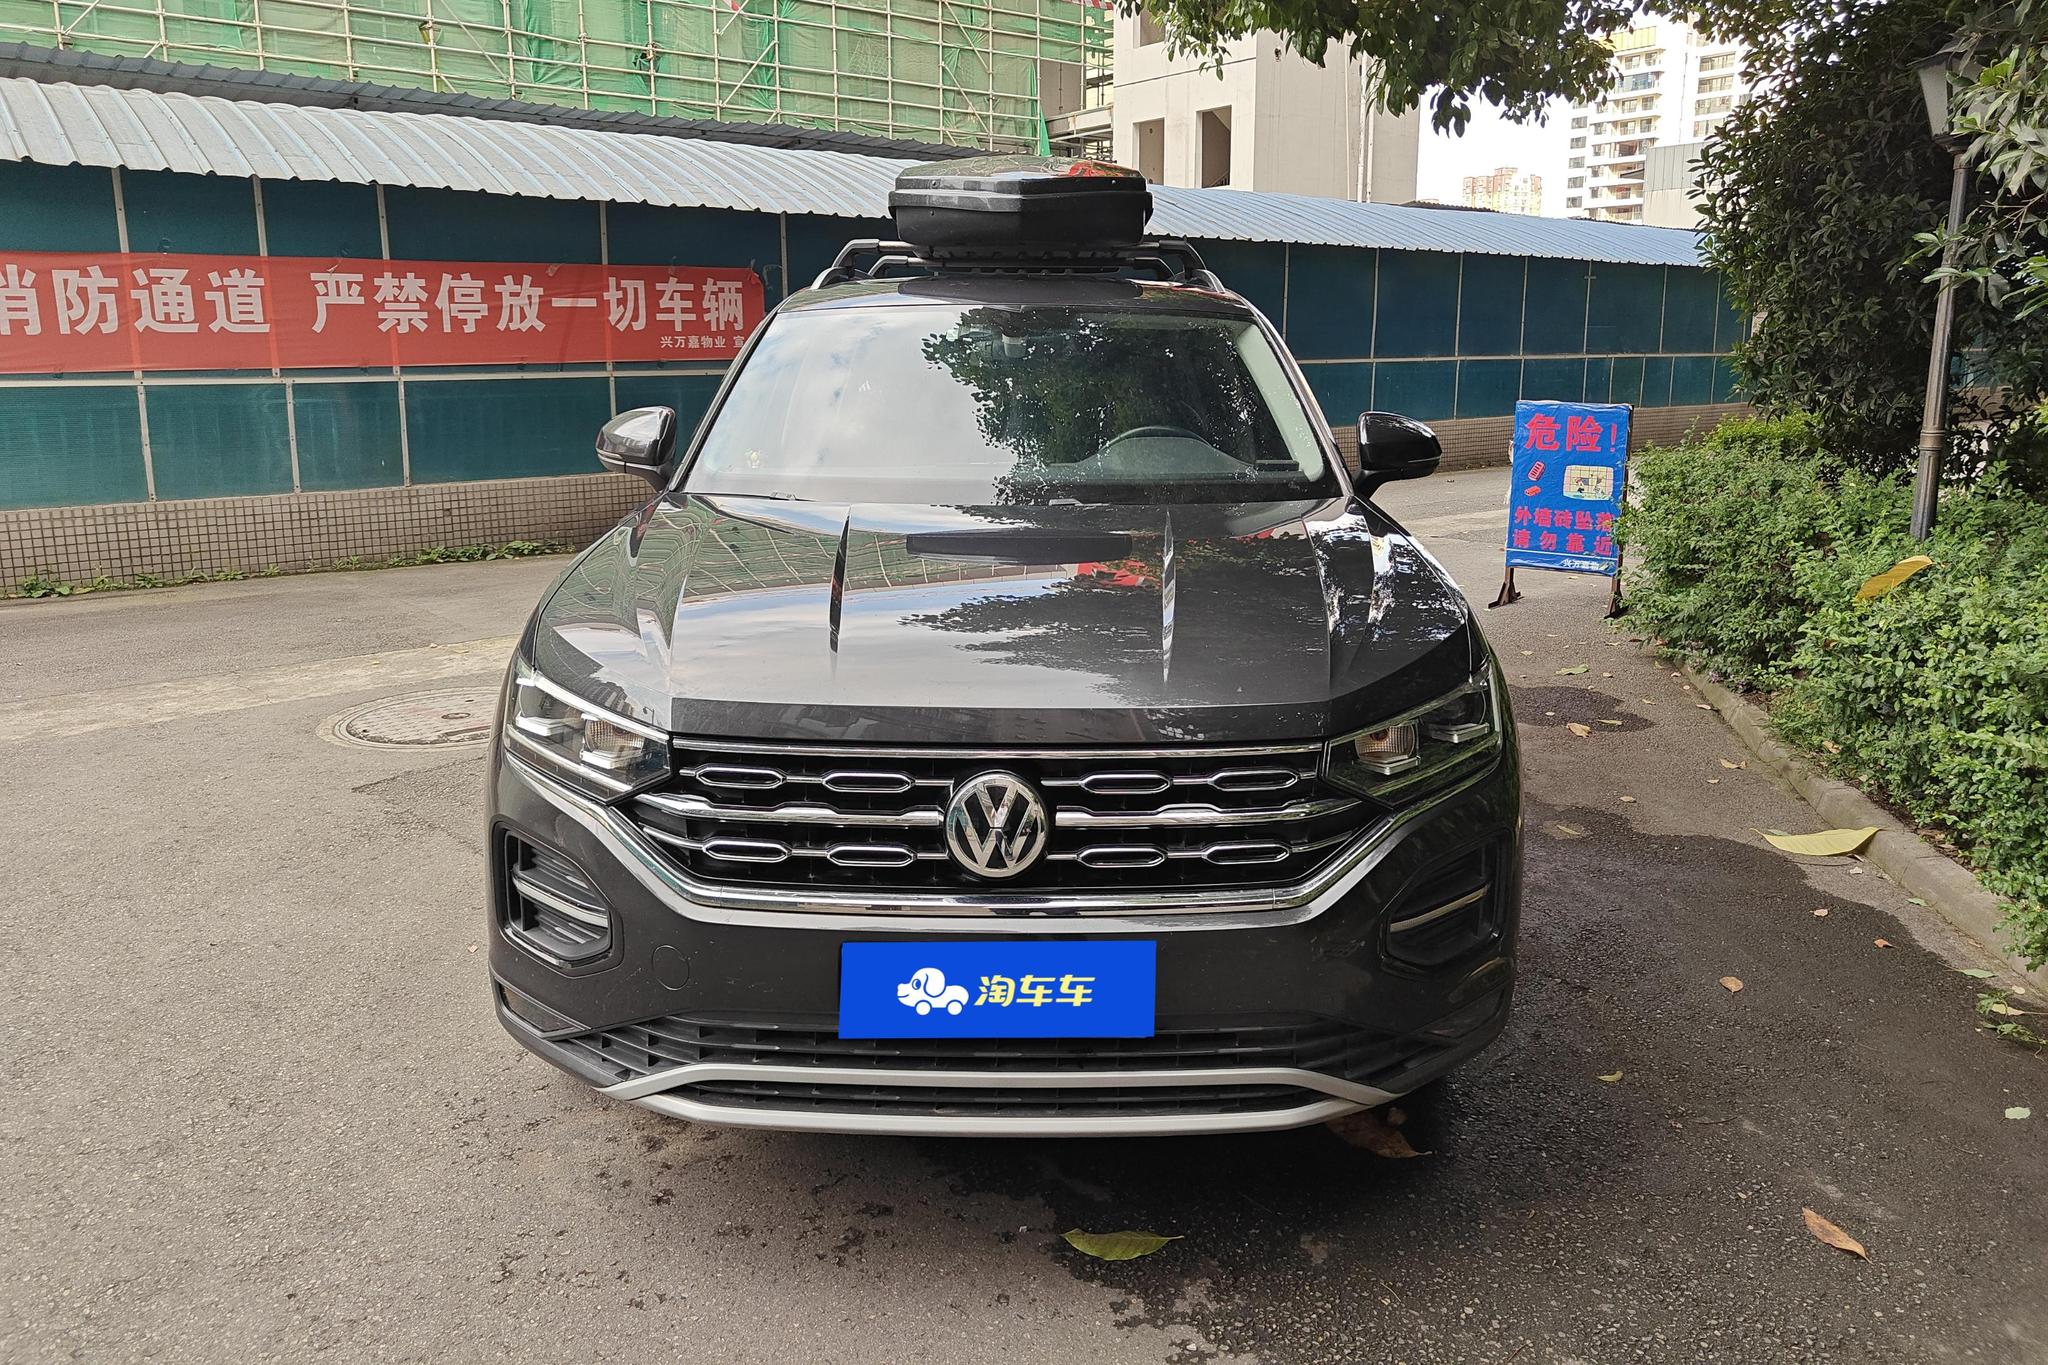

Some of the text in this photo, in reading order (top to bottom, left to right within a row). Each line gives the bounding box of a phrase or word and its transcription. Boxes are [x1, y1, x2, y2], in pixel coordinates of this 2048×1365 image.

[0, 264, 745, 336] 消防通道 严禁停放一切车辆
[660, 335, 727, 349] 兴万嘉物业
[1512, 529, 1613, 556] 请勿靠近
